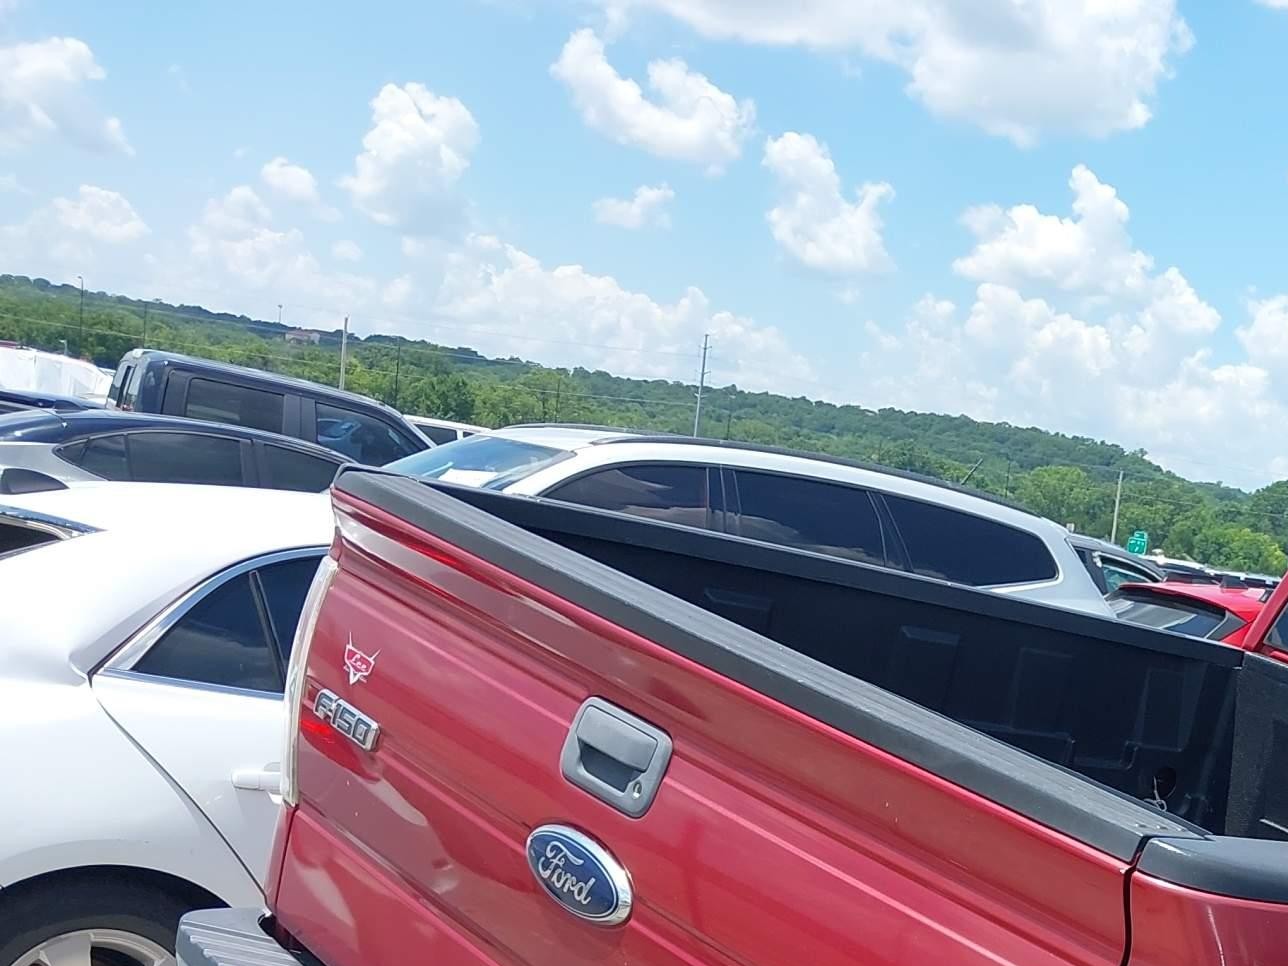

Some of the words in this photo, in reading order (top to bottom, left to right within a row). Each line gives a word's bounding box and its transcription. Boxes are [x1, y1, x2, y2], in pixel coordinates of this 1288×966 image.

[350, 653, 368, 672] Lee
[314, 689, 379, 751] F-150
[538, 841, 596, 905] Ford
